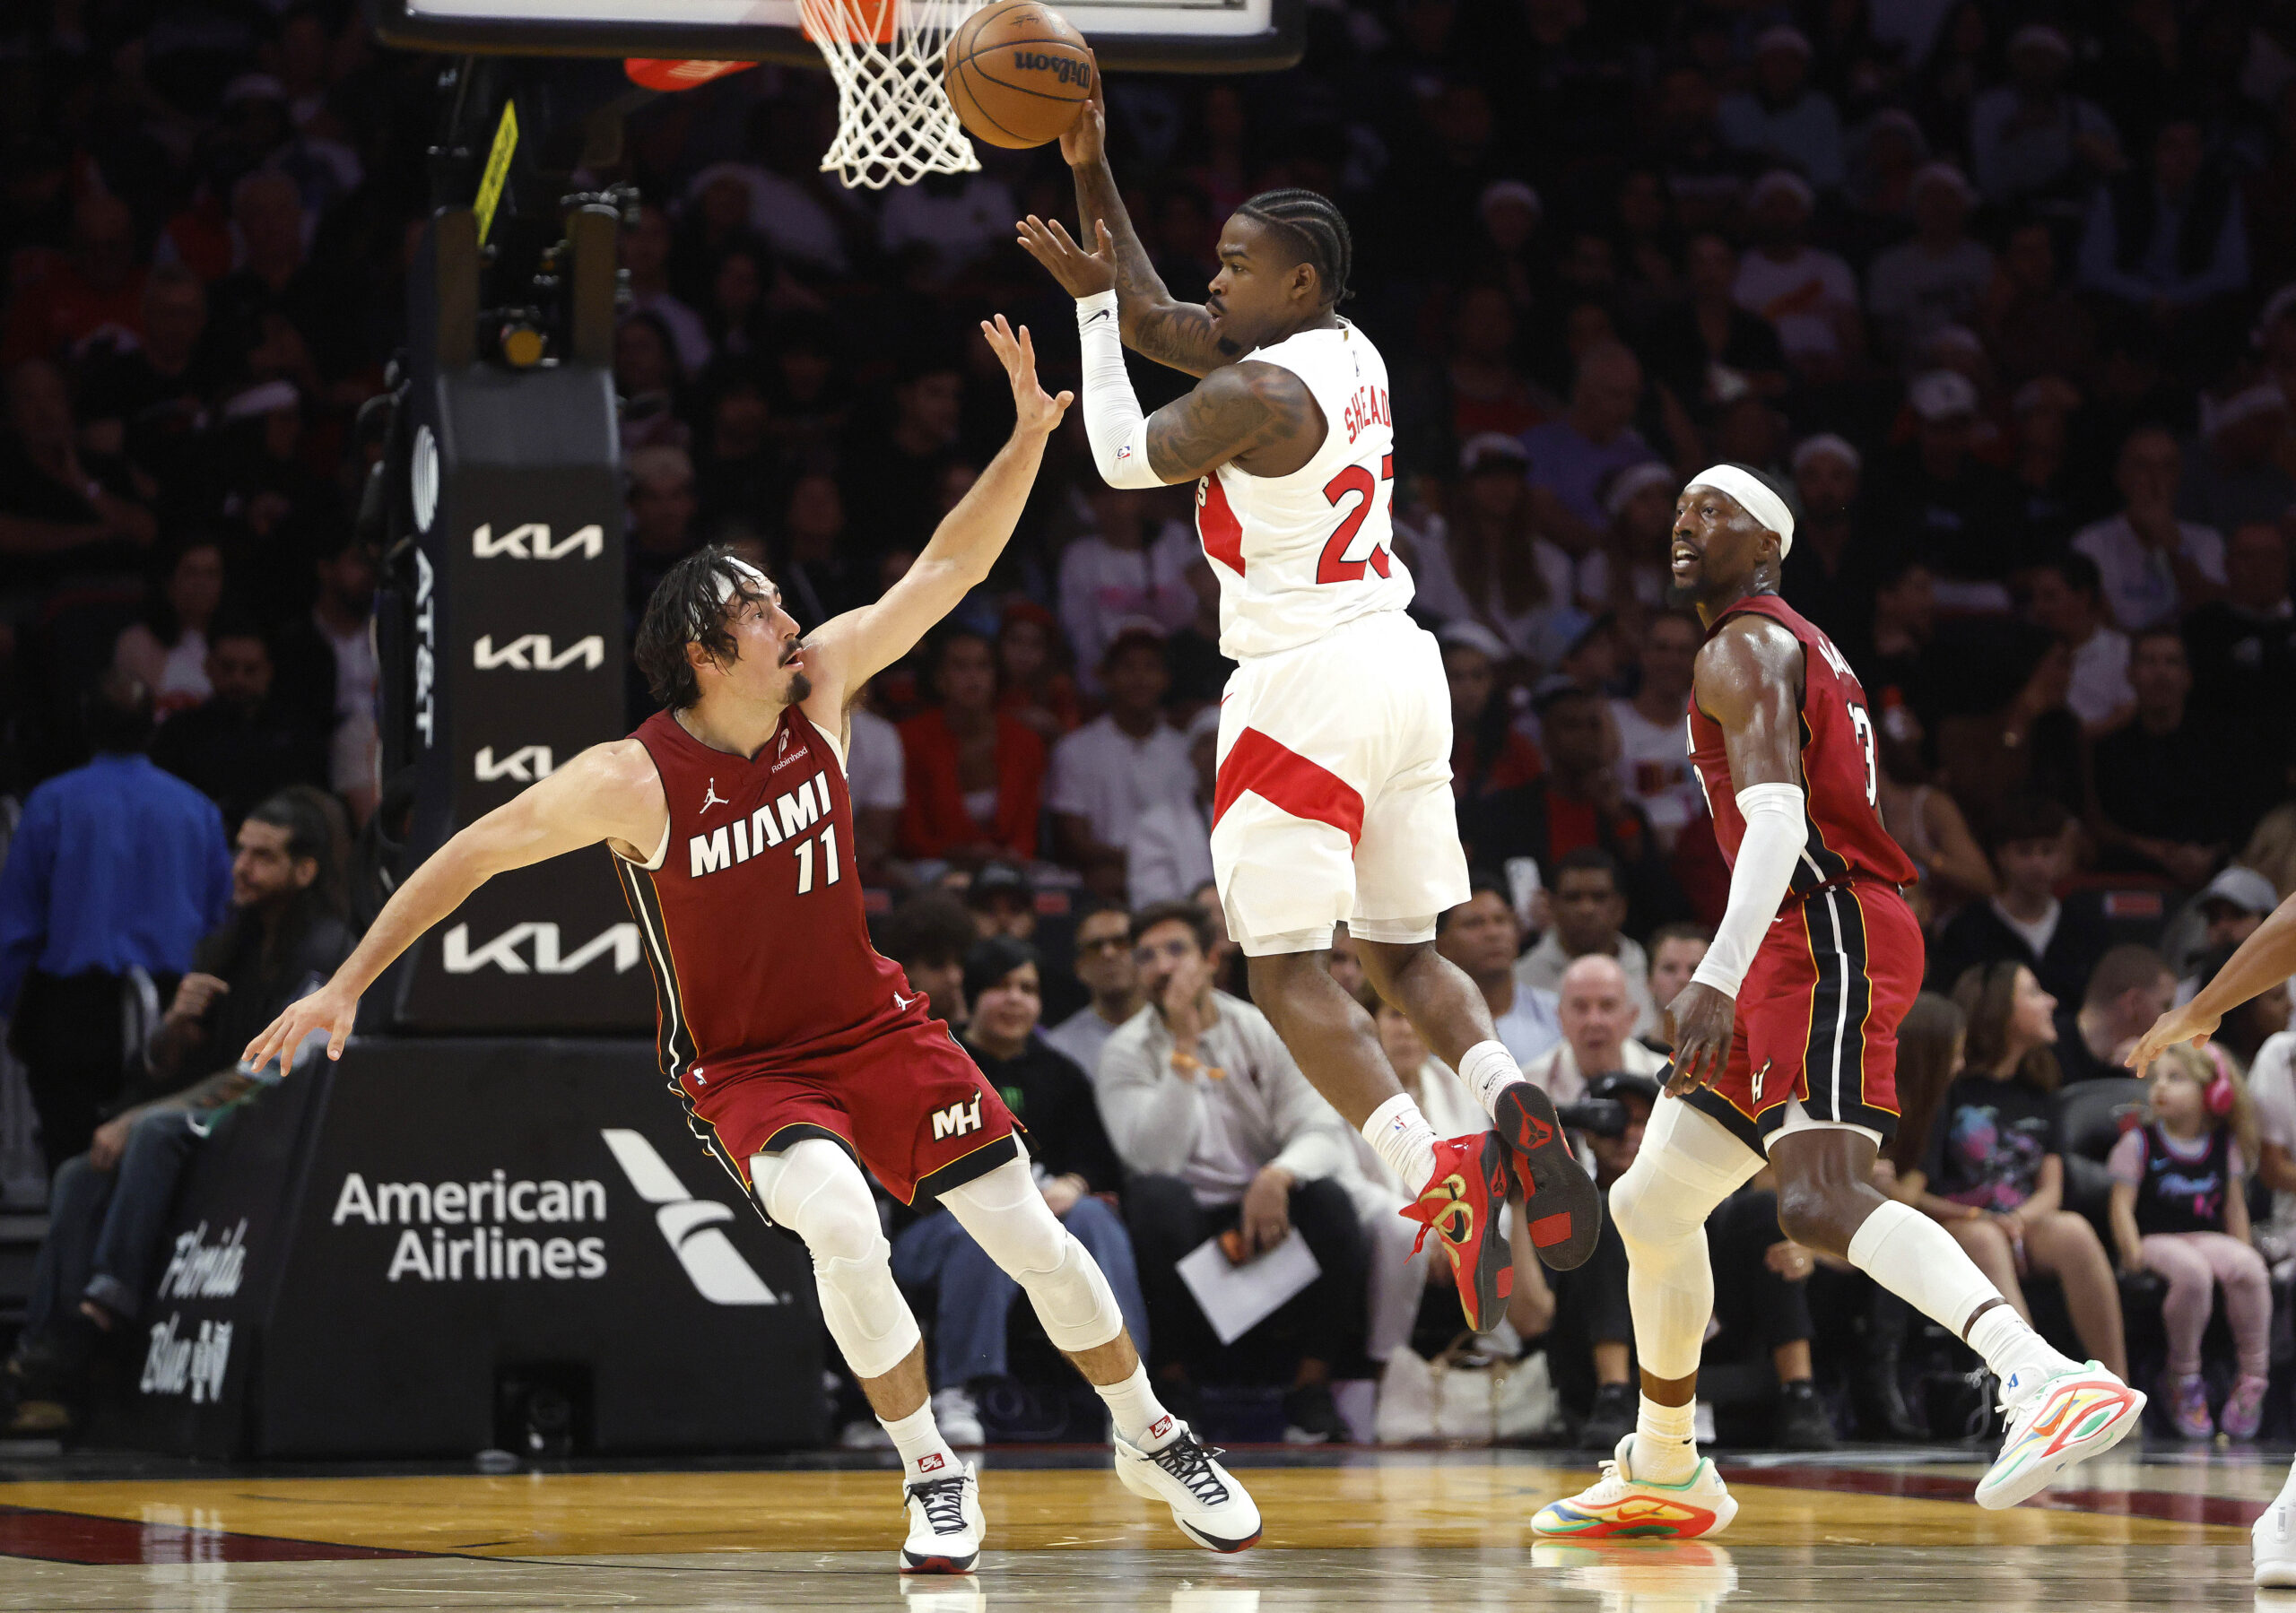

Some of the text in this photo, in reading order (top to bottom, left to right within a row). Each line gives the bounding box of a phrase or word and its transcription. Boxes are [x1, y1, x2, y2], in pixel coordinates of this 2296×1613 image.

[1014, 51, 1090, 89] Wilson
[1345, 385, 1391, 444] SHEAD
[473, 523, 604, 559] KIA
[415, 547, 434, 749] AT&T
[474, 634, 604, 671] KIA
[475, 745, 576, 782] KI
[771, 746, 808, 774] Robinhood
[689, 769, 832, 878] MIAMI
[795, 822, 840, 895] 11
[443, 921, 641, 975] KIA
[333, 1169, 607, 1226] American
[158, 1216, 248, 1300] Florida
[387, 1227, 608, 1281] Airlines
[140, 1310, 192, 1394] Blue
